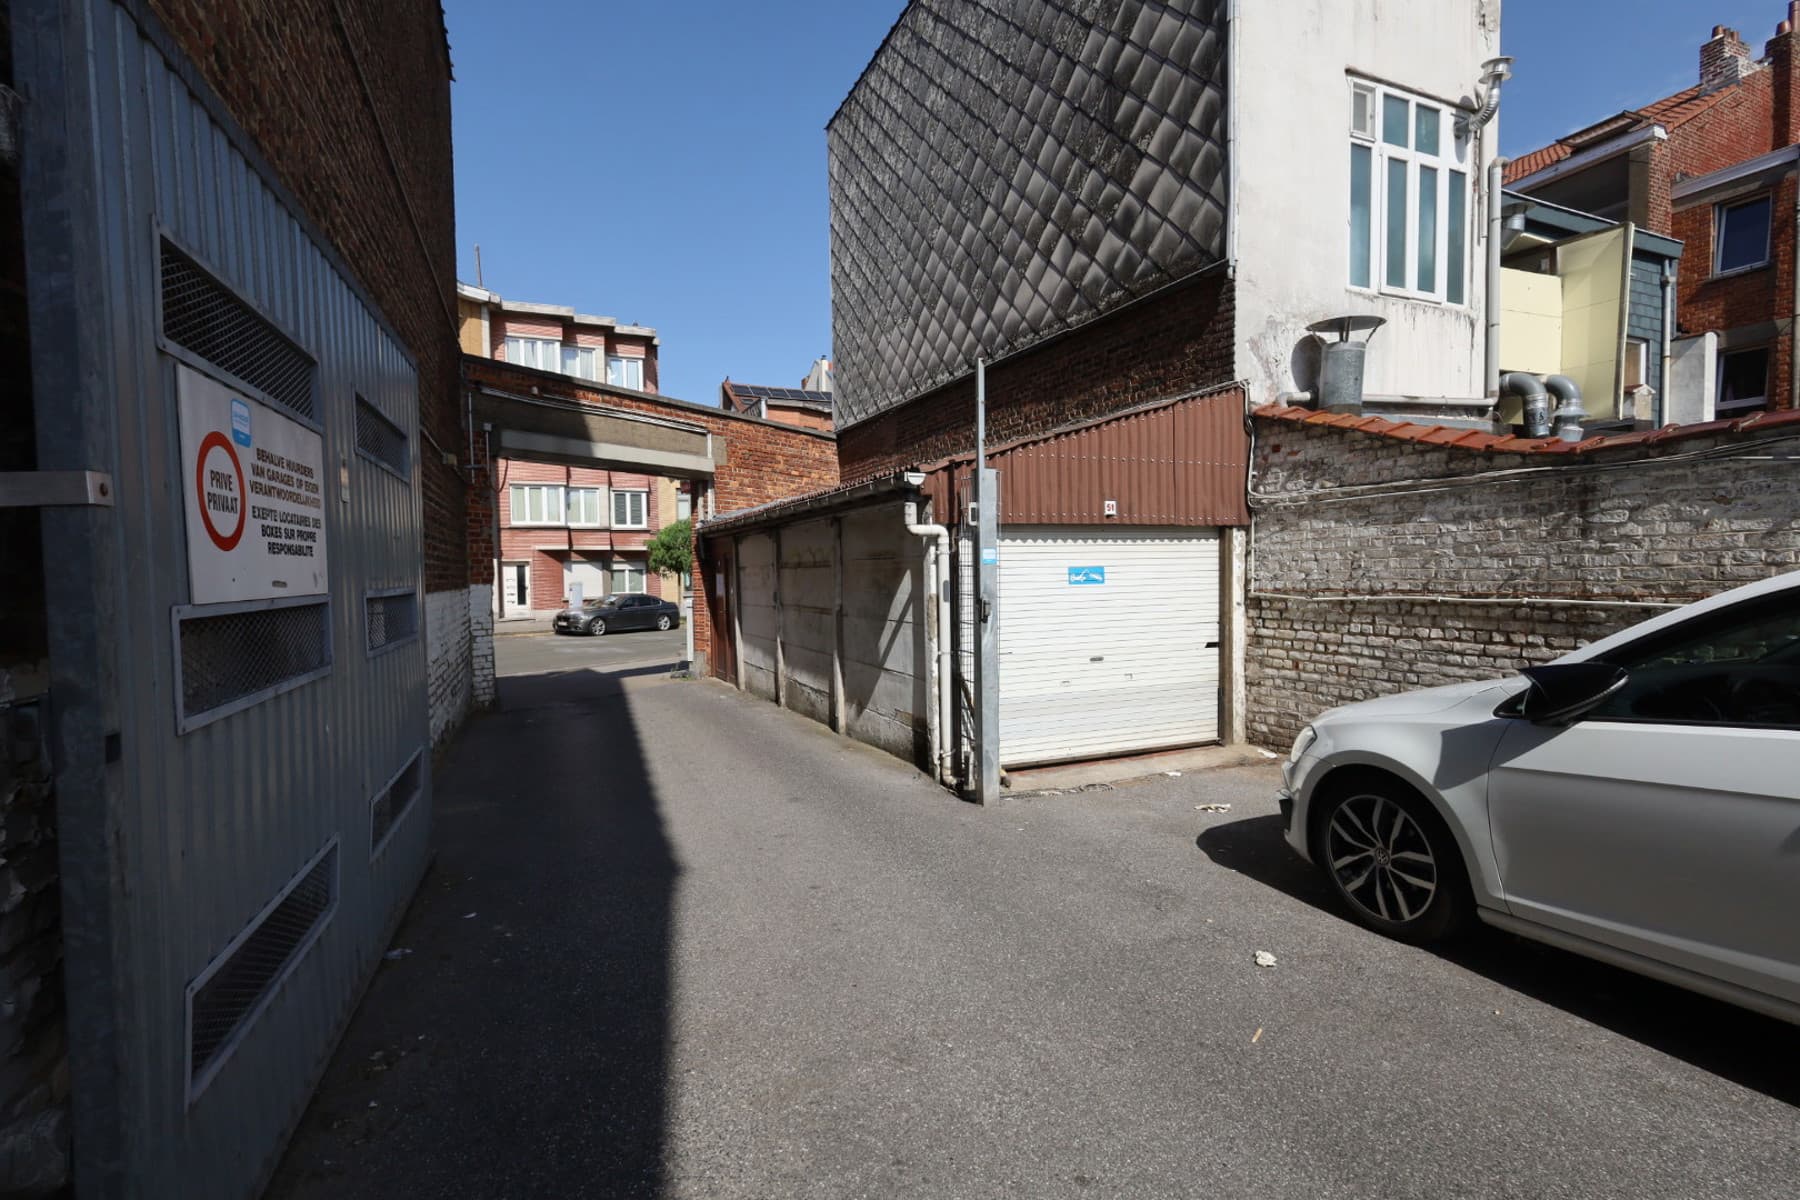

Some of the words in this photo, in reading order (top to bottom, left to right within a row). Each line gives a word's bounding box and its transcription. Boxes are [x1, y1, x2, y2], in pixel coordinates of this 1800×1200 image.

[256, 447, 285, 468] BEHALVE
[286, 458, 314, 479] HUURDERS
[210, 470, 233, 491] PRIVE
[250, 462, 266, 479] VAN
[267, 468, 295, 487] GARAGES
[296, 477, 304, 490] OP
[207, 491, 238, 514] PRIVAAT
[279, 509, 311, 529] LOCATAIRES
[312, 518, 321, 530] DES
[261, 524, 283, 540] BOXES
[284, 527, 296, 540] SUR
[296, 530, 317, 543] PROPRE
[267, 541, 314, 558] RESPONSABILITE
